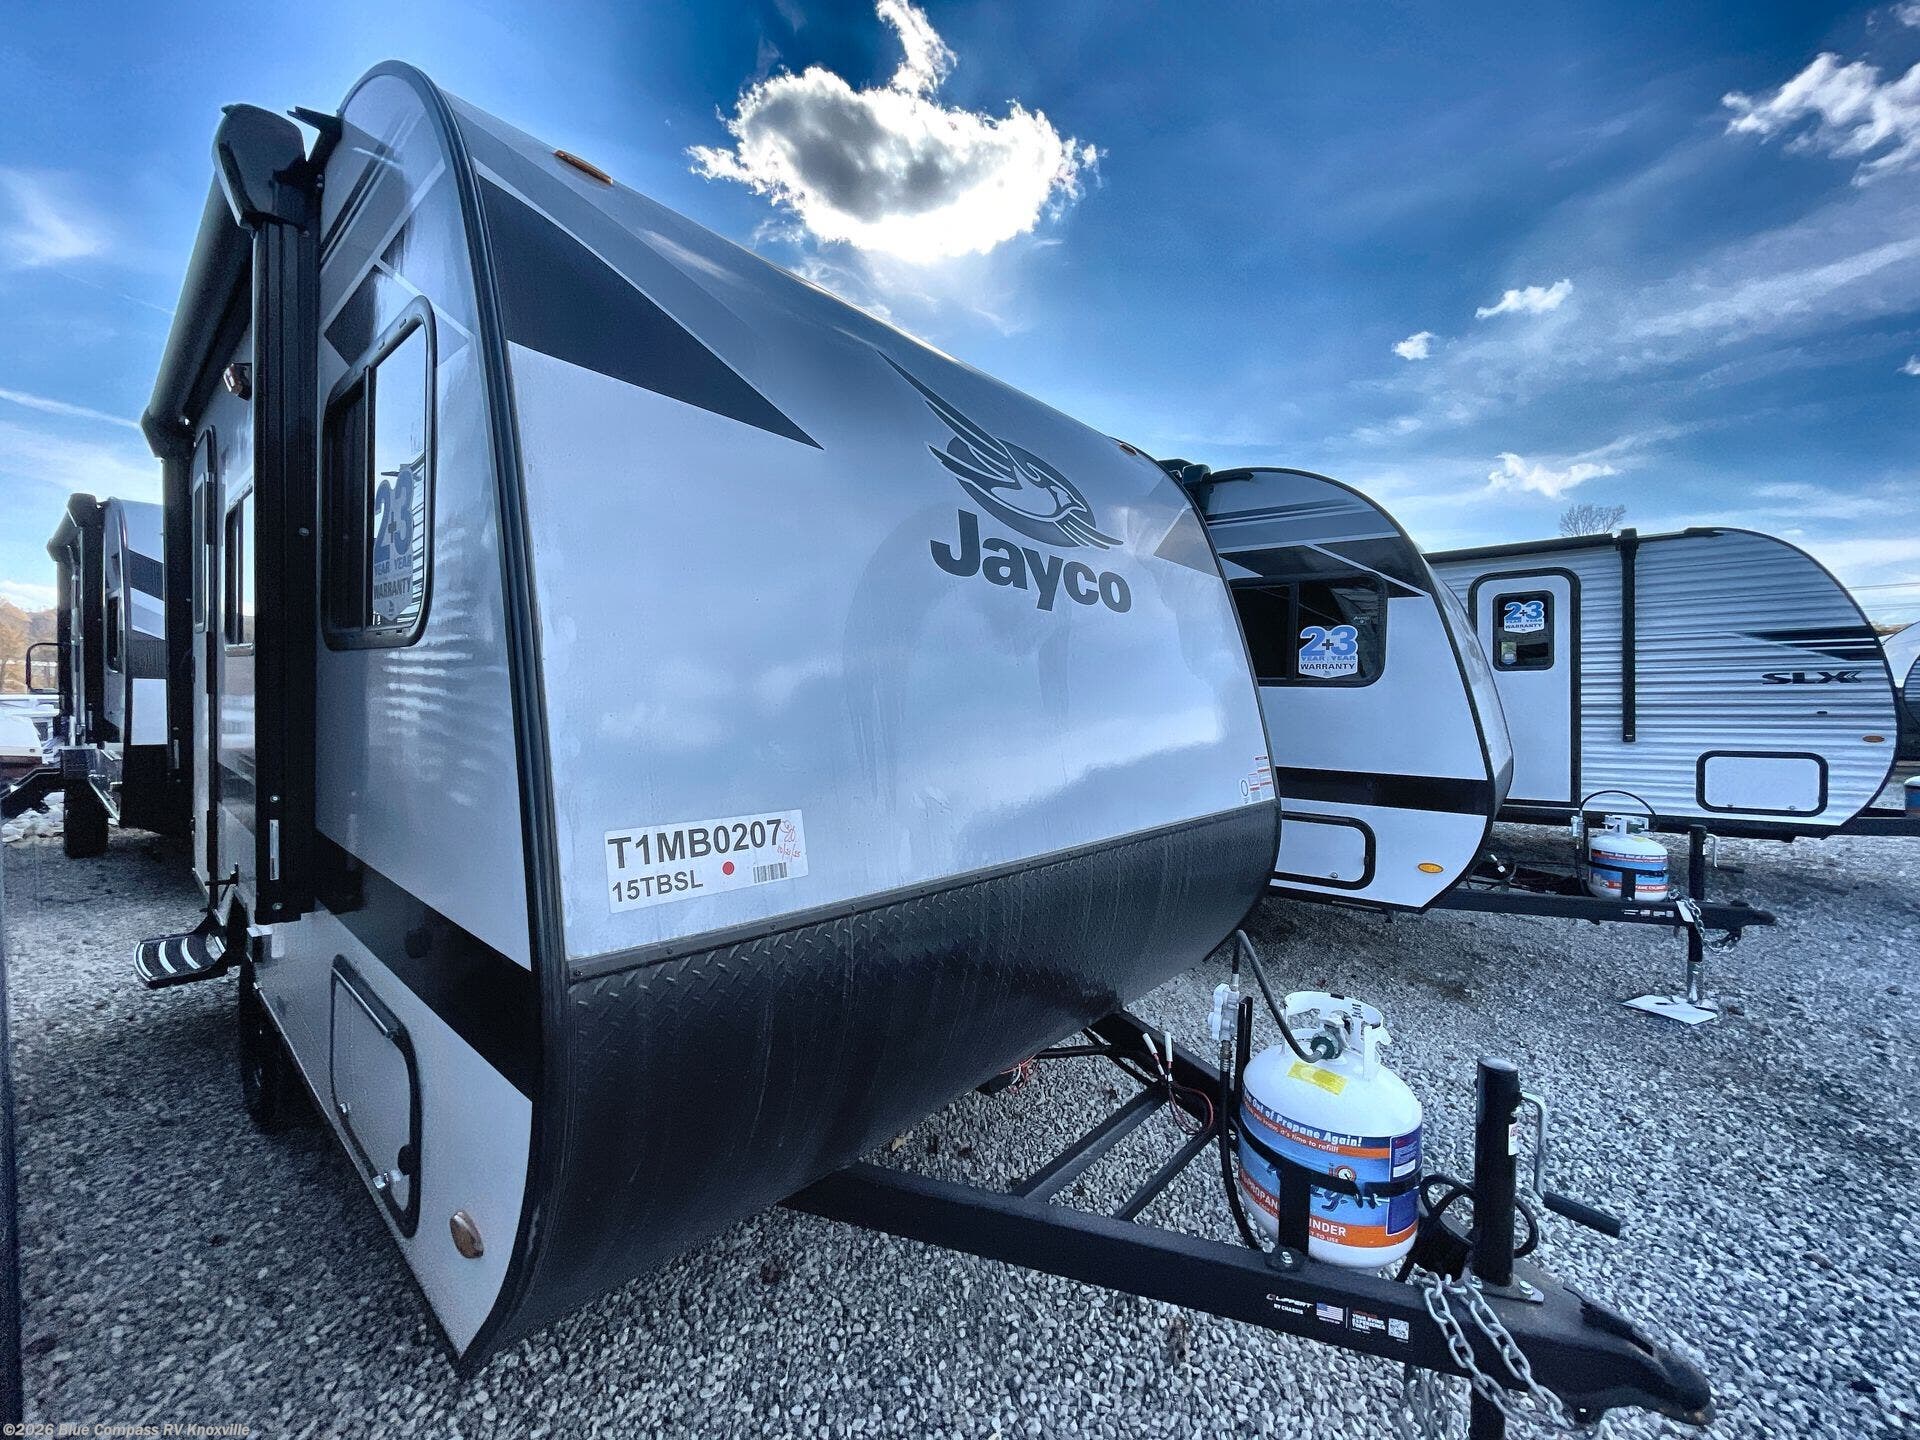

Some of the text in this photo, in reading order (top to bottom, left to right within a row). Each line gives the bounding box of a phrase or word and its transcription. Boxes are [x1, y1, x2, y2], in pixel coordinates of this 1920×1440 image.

[930, 508, 1132, 613] Jayco
[373, 577, 412, 601] WARRANTY
[1505, 601, 1543, 621] 2+3
[1301, 626, 1357, 656] 2+3
[607, 818, 782, 869] T1MB0207
[612, 869, 704, 903] 15TBSL
[1252, 1098, 1264, 1114] Out
[1265, 1109, 1275, 1121] of
[1276, 1114, 1321, 1140] Propane
[1323, 1130, 1363, 1147] Again!
[1291, 1133, 1307, 1144] time
[1318, 1143, 1339, 1153] refill!
[1309, 1218, 1347, 1237] INDER
